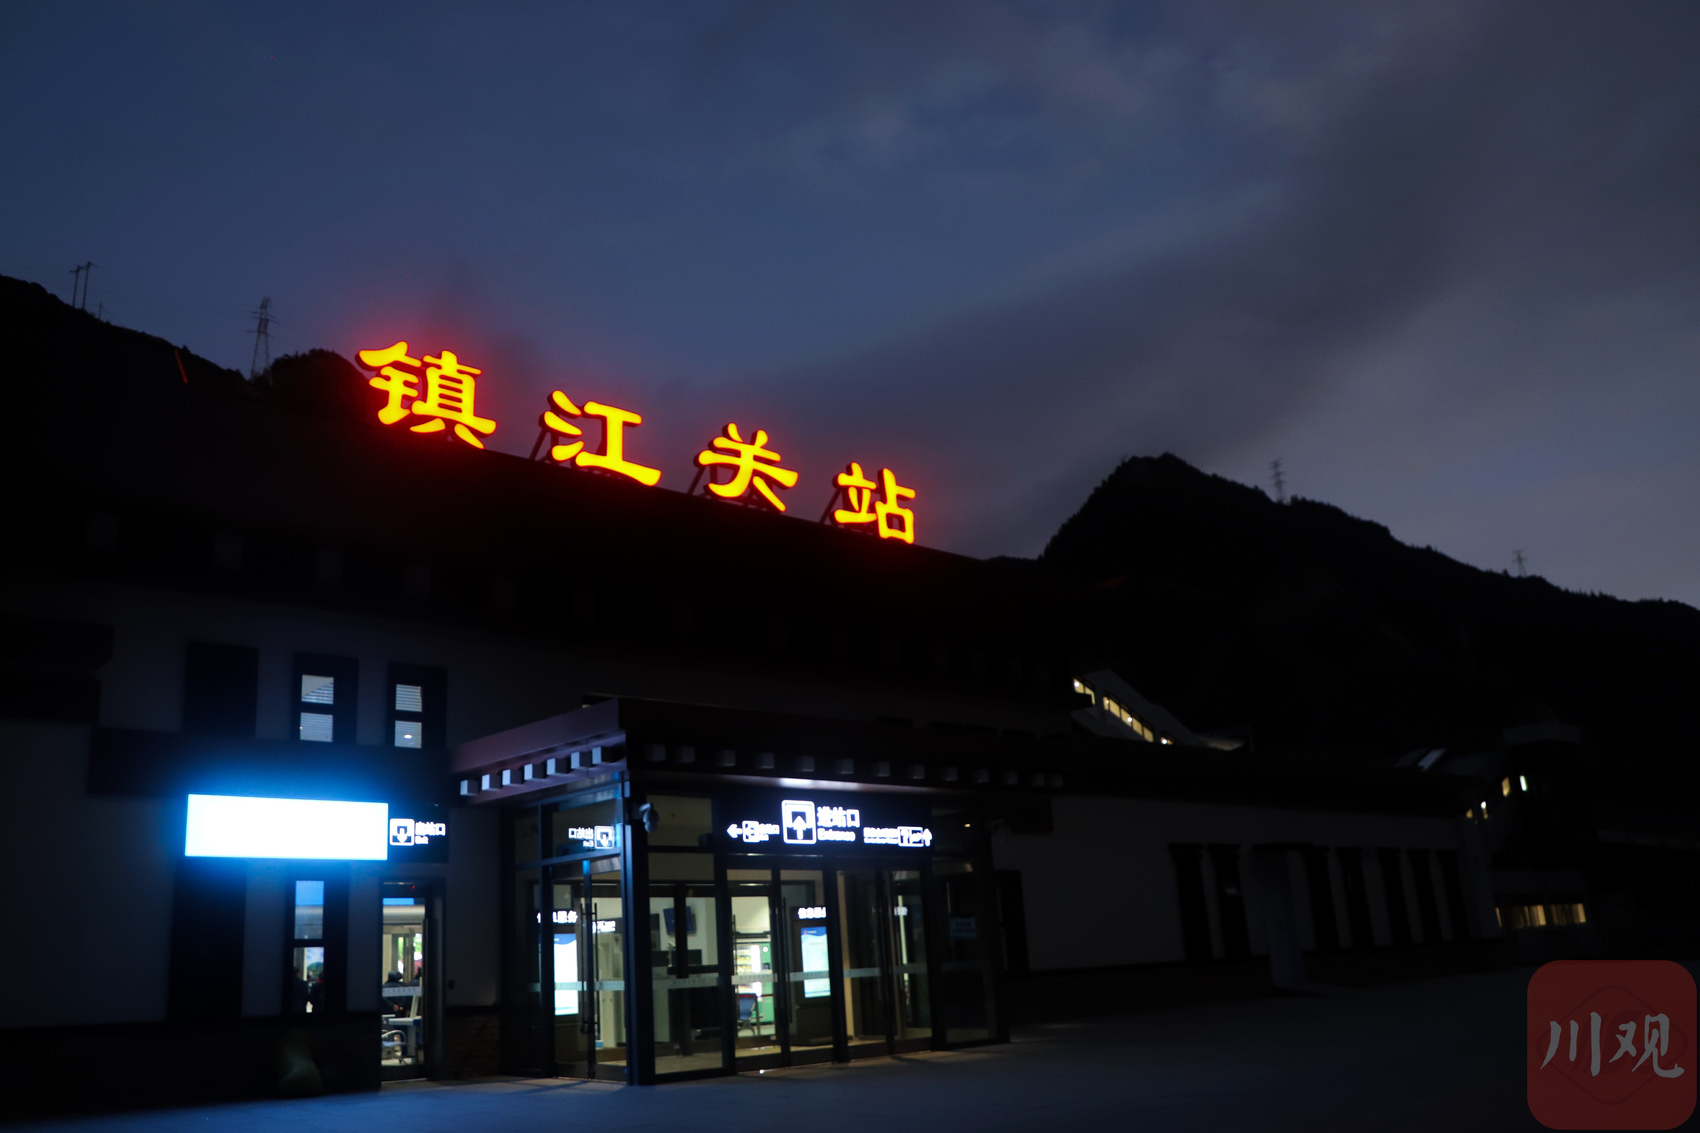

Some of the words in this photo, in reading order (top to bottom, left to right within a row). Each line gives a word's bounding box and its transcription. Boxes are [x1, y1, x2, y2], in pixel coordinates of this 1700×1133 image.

[358, 341, 916, 544] 镇江关站
[817, 806, 860, 827] 进站口
